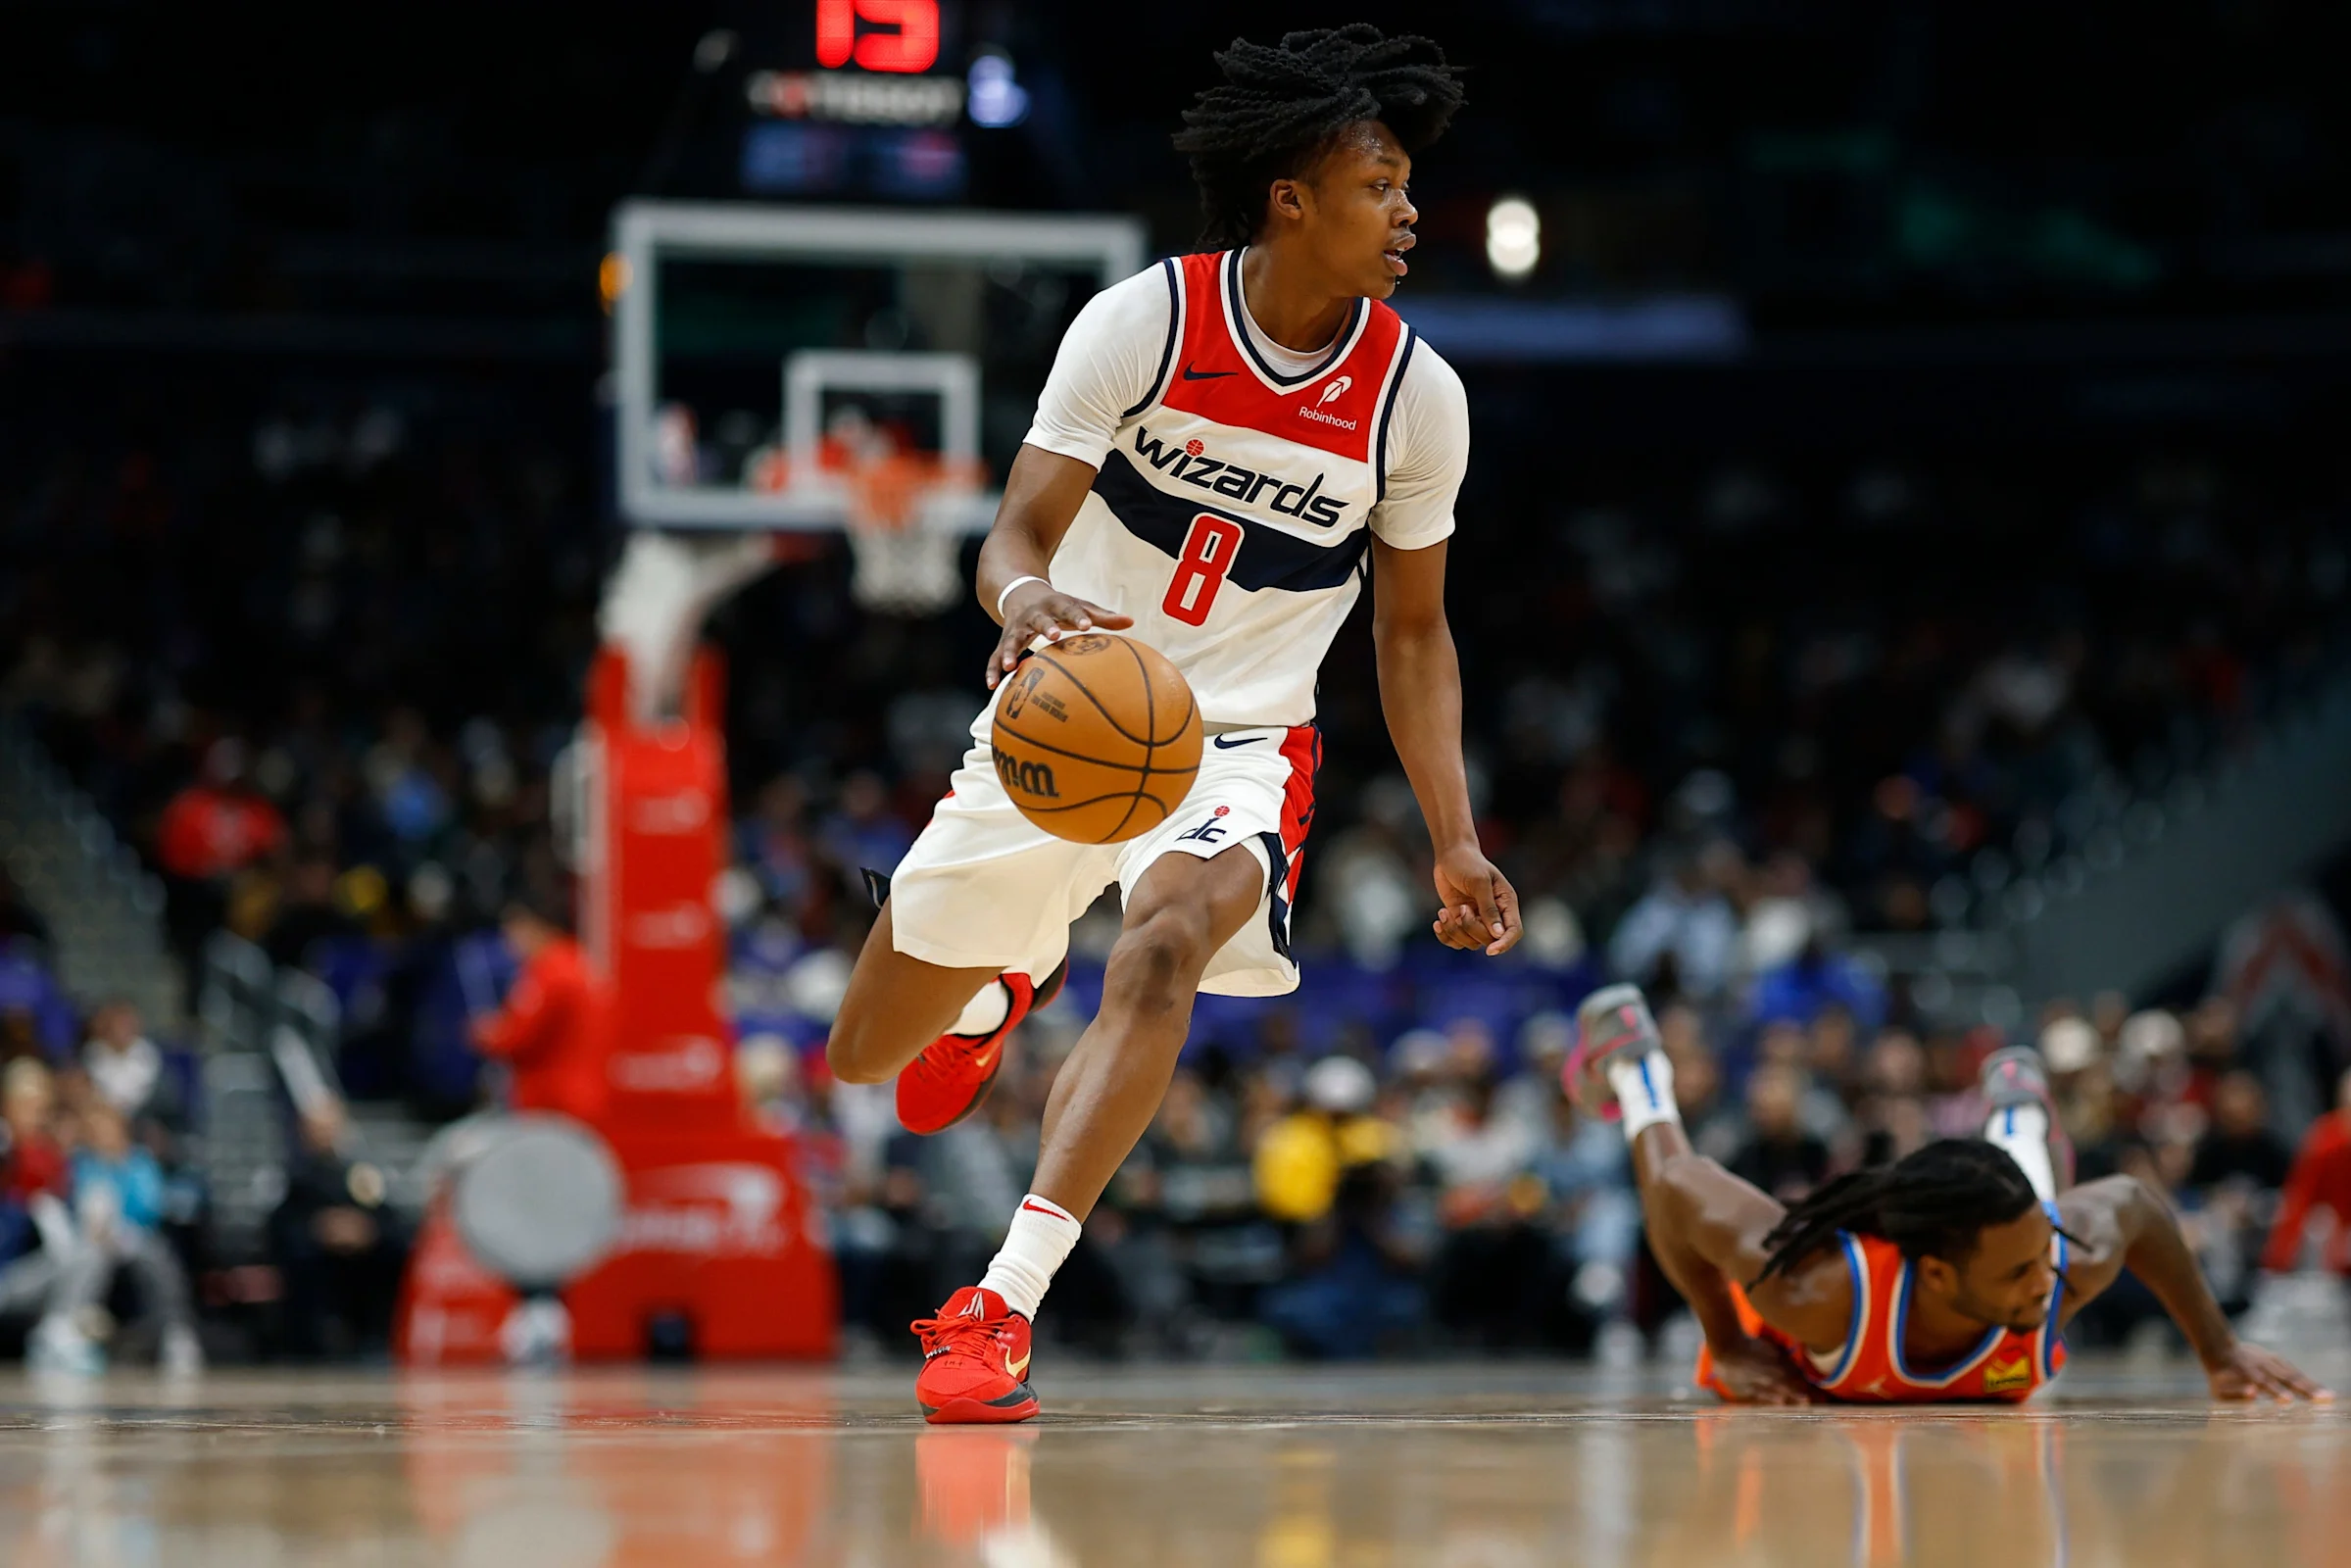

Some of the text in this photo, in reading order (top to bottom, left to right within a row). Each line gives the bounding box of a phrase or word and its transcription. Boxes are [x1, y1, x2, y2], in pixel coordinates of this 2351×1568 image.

[1298, 406, 1357, 431] Robinhood
[1134, 425, 1350, 528] wizards
[1160, 513, 1245, 628] 8
